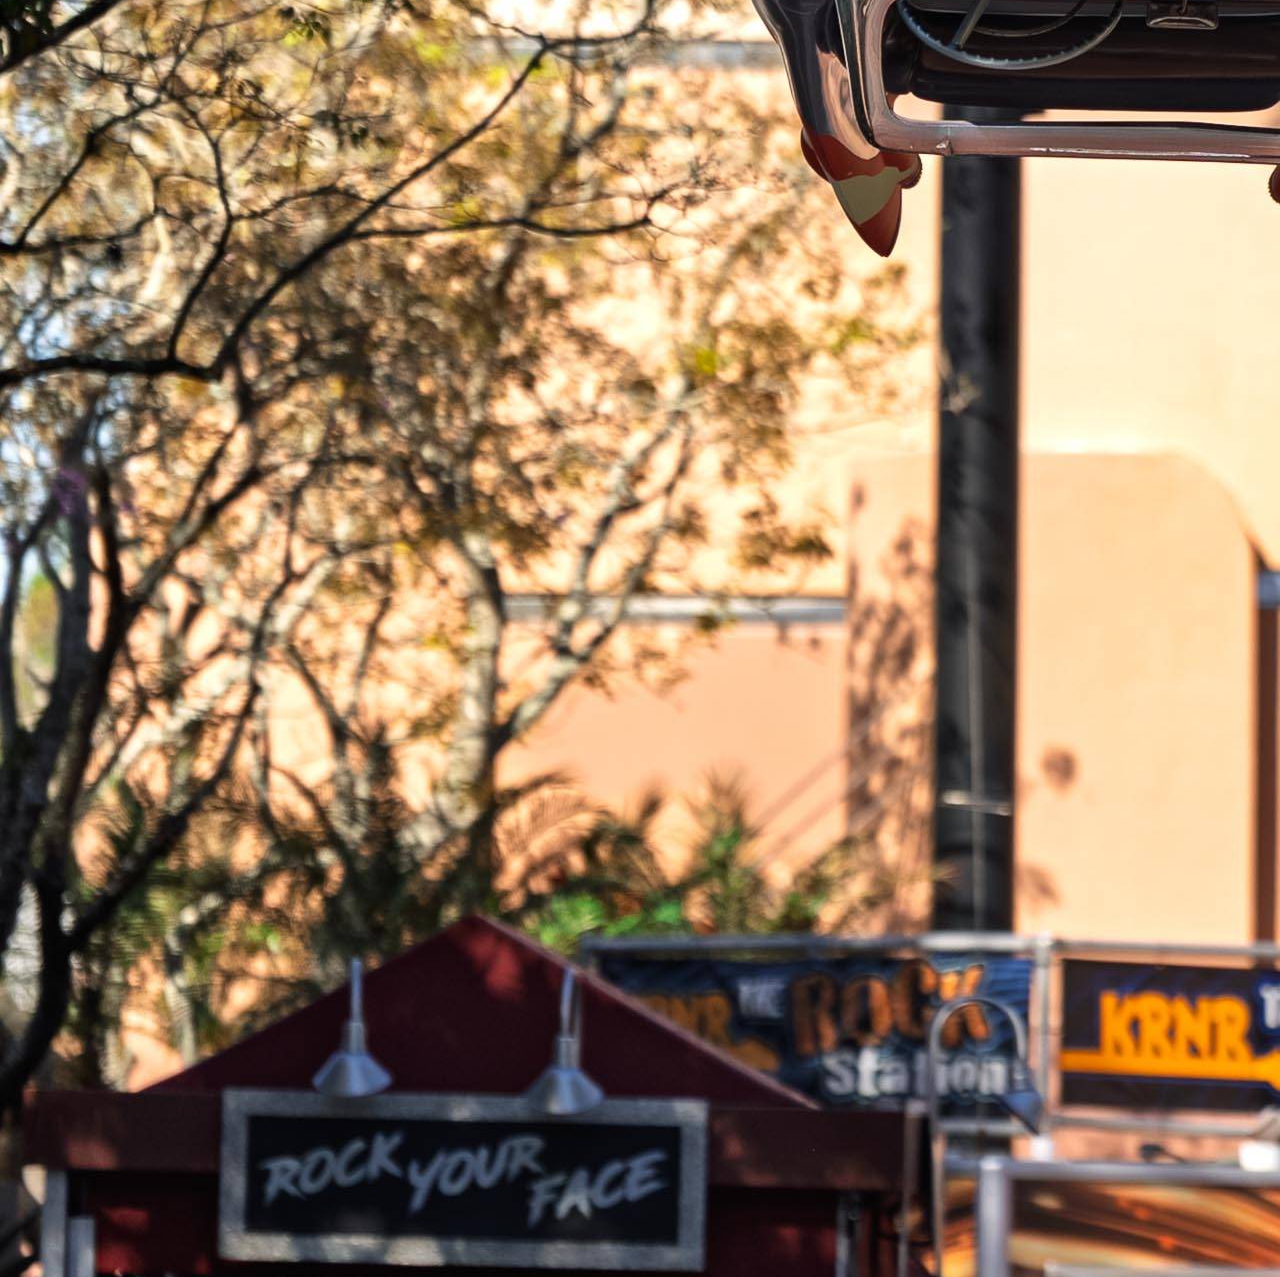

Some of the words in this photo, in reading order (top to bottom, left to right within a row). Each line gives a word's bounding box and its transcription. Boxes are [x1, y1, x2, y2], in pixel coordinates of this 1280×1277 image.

[792, 958, 994, 1058] ROCK
[262, 1131, 402, 1204] ROCK
[407, 1134, 546, 1214] YOUR
[527, 1149, 668, 1227] FACE
